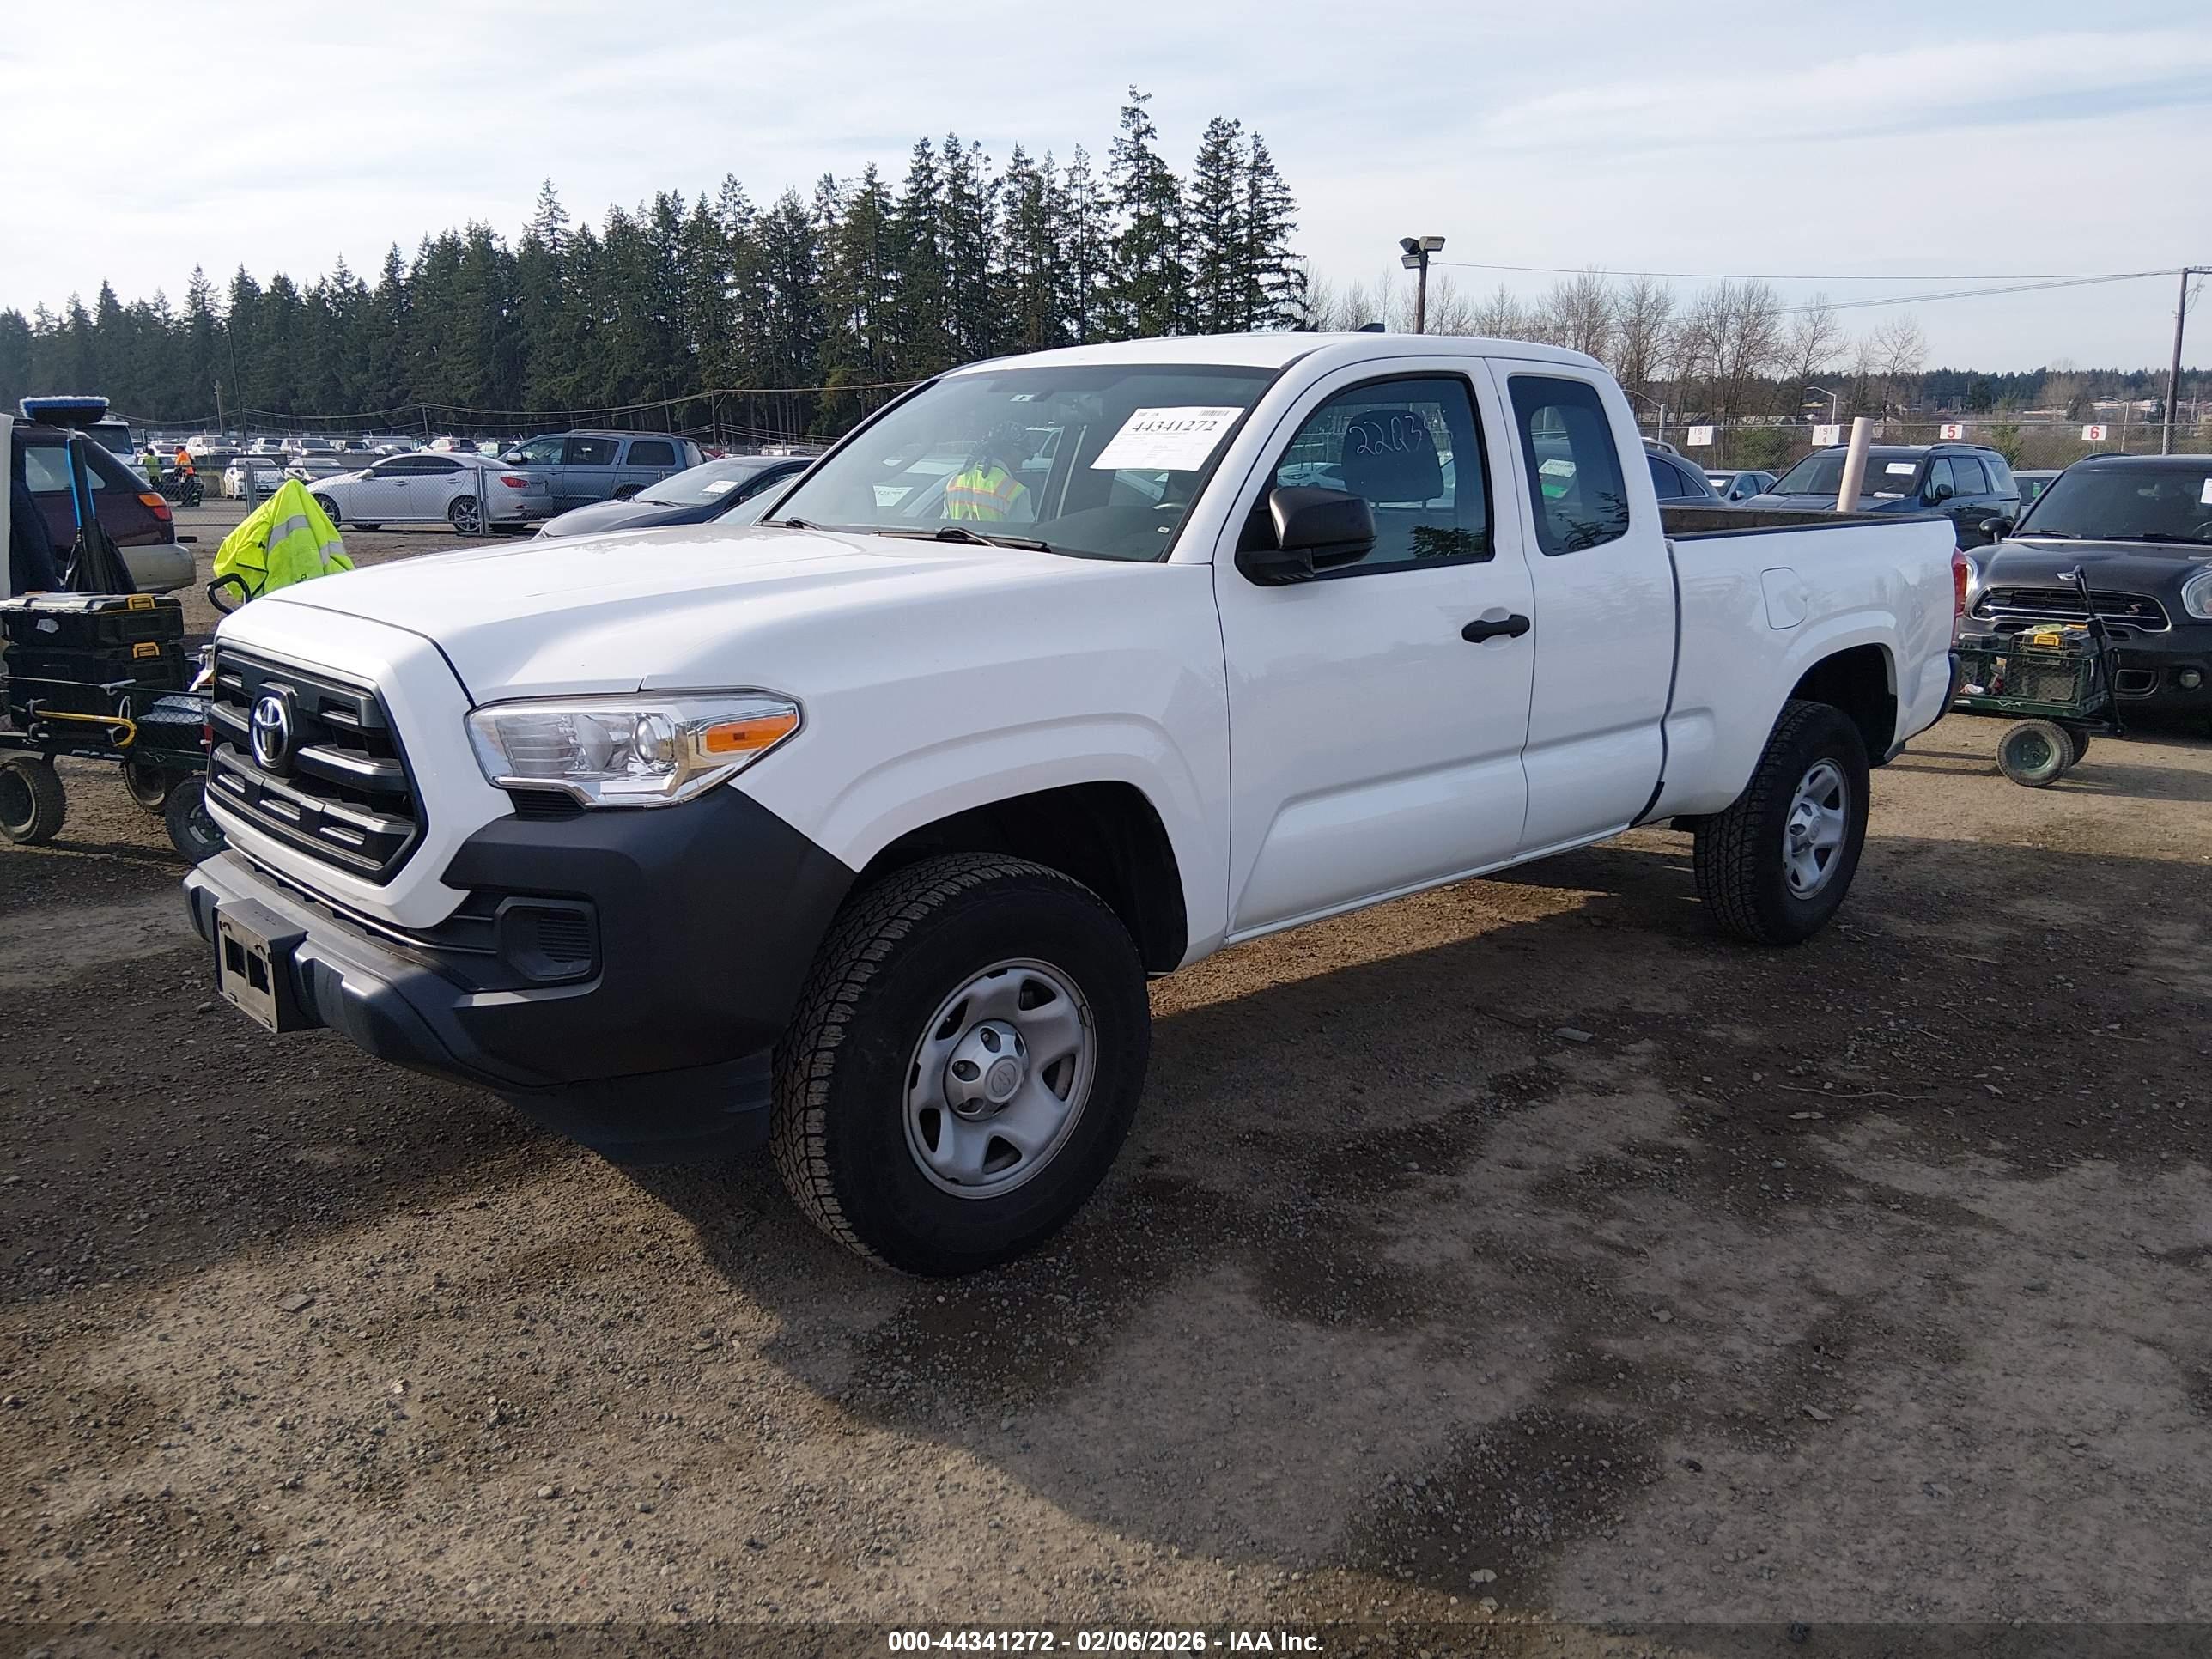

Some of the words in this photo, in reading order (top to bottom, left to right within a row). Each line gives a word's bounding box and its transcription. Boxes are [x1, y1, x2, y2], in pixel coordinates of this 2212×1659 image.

[1132, 420, 1218, 432] 44341272
[1947, 425, 1956, 439] 5
[2089, 426, 2100, 440] 6
